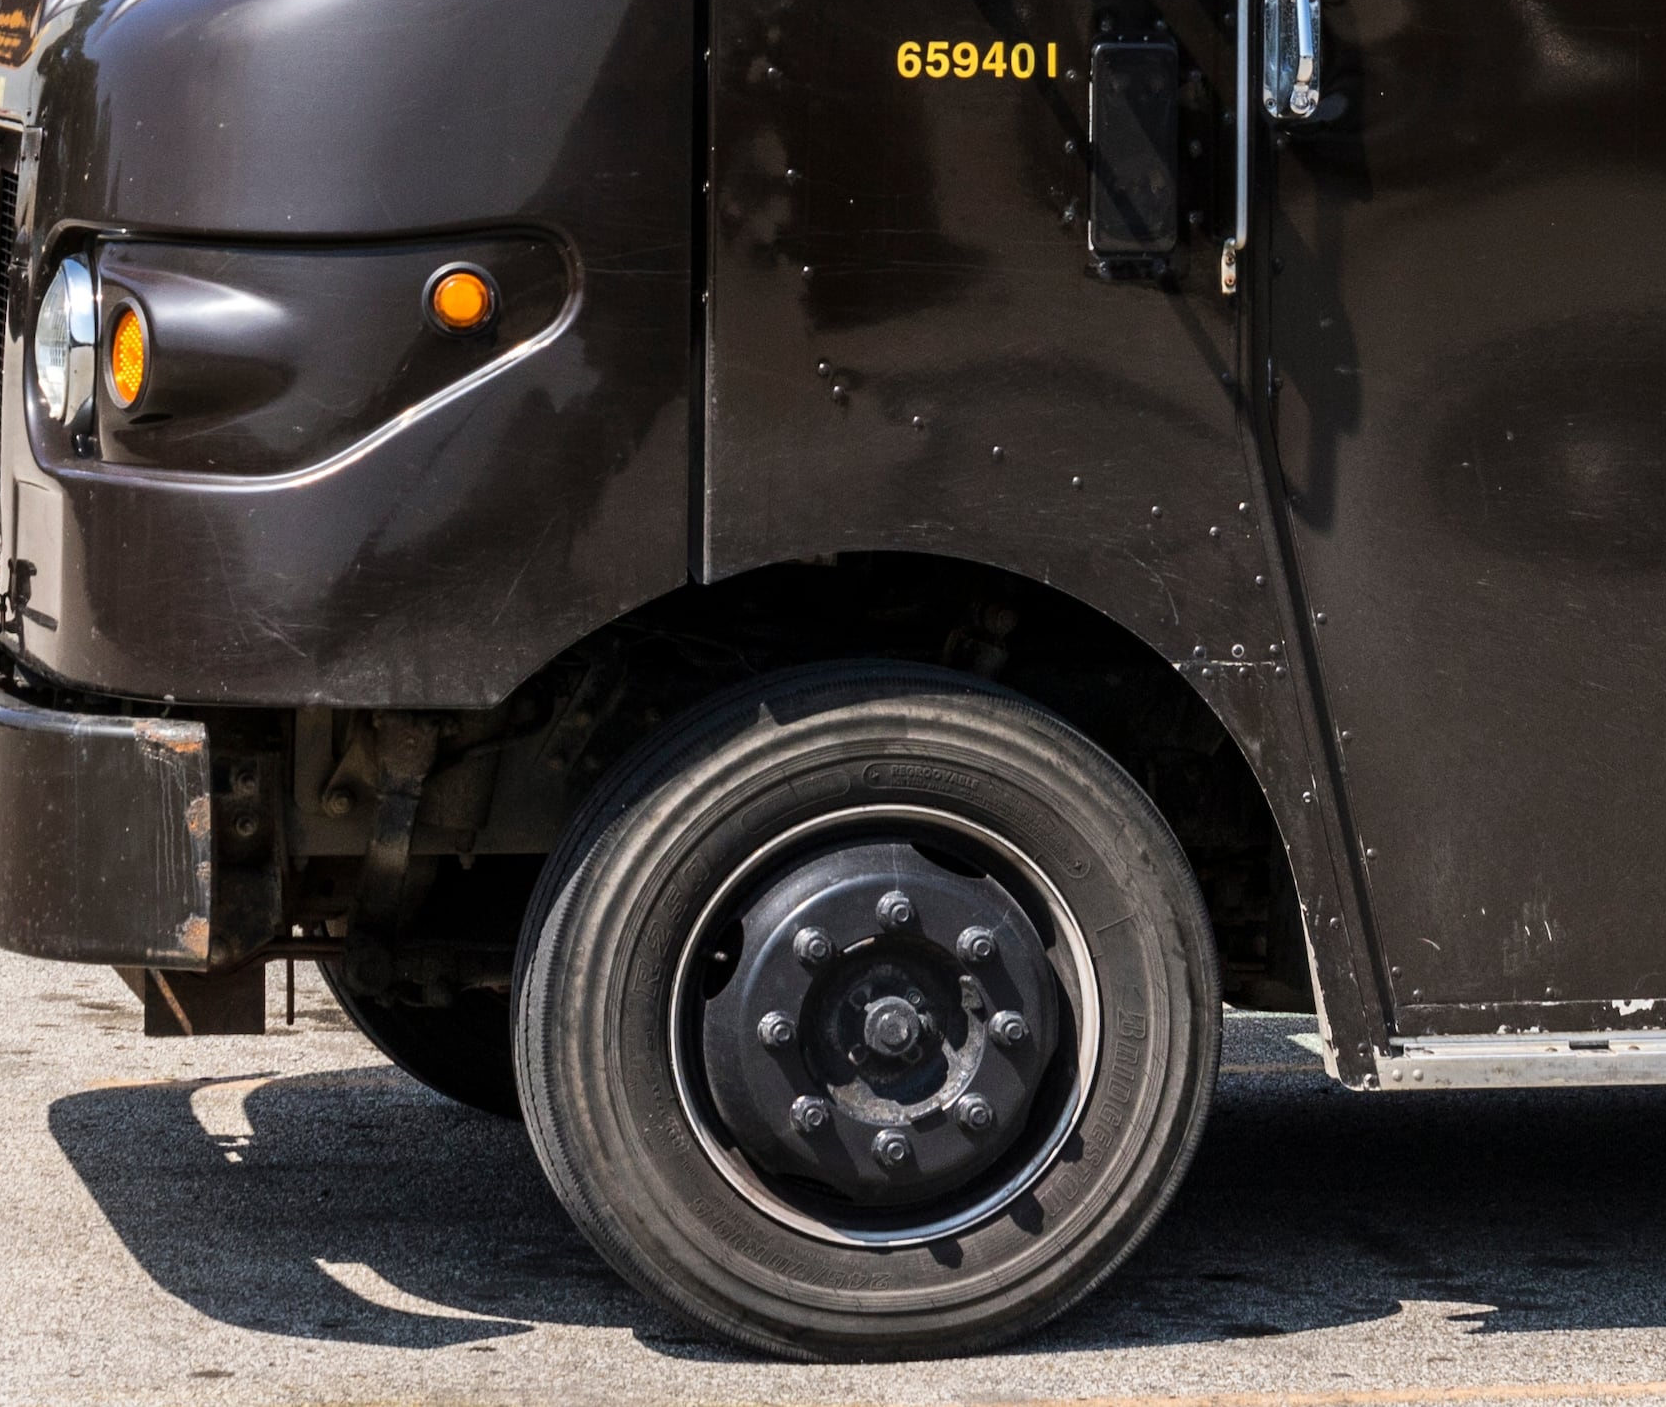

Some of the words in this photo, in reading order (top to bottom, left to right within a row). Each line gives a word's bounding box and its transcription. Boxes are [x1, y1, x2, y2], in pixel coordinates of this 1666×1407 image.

[896, 41, 1057, 79] 659401
[890, 763, 982, 792] REGROOVABLE
[1027, 1008, 1147, 1228] BRIDGESTON
